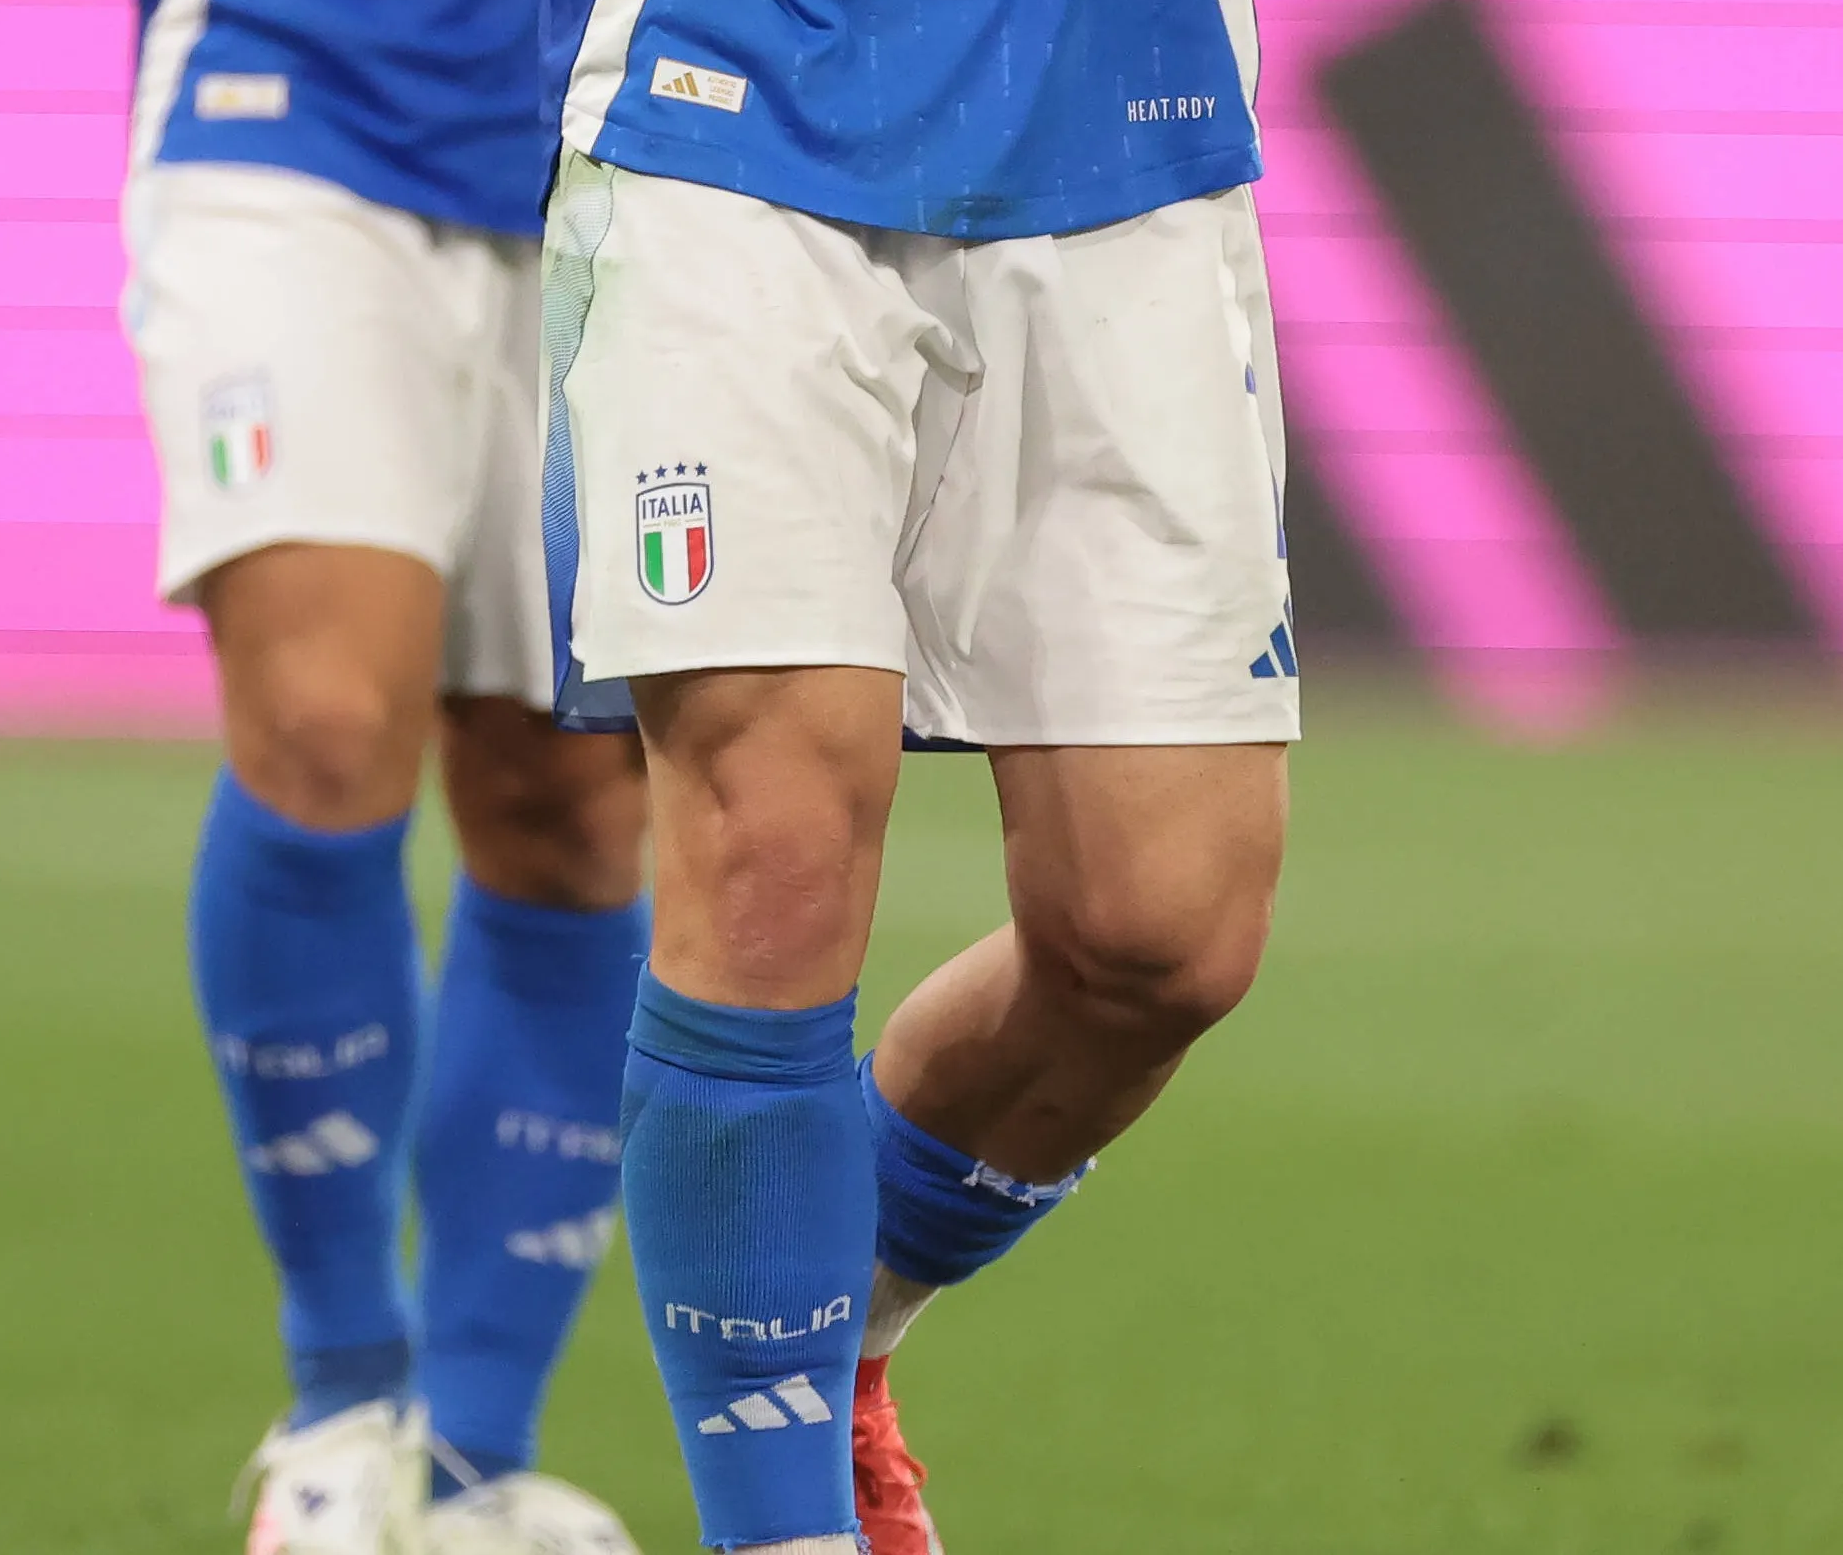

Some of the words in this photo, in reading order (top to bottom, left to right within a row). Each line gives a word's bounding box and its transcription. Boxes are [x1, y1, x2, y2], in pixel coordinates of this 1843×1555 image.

[1127, 96, 1216, 123] HEAT.RDY
[642, 493, 704, 520] ITALIA
[665, 1294, 851, 1341] ITALIA
